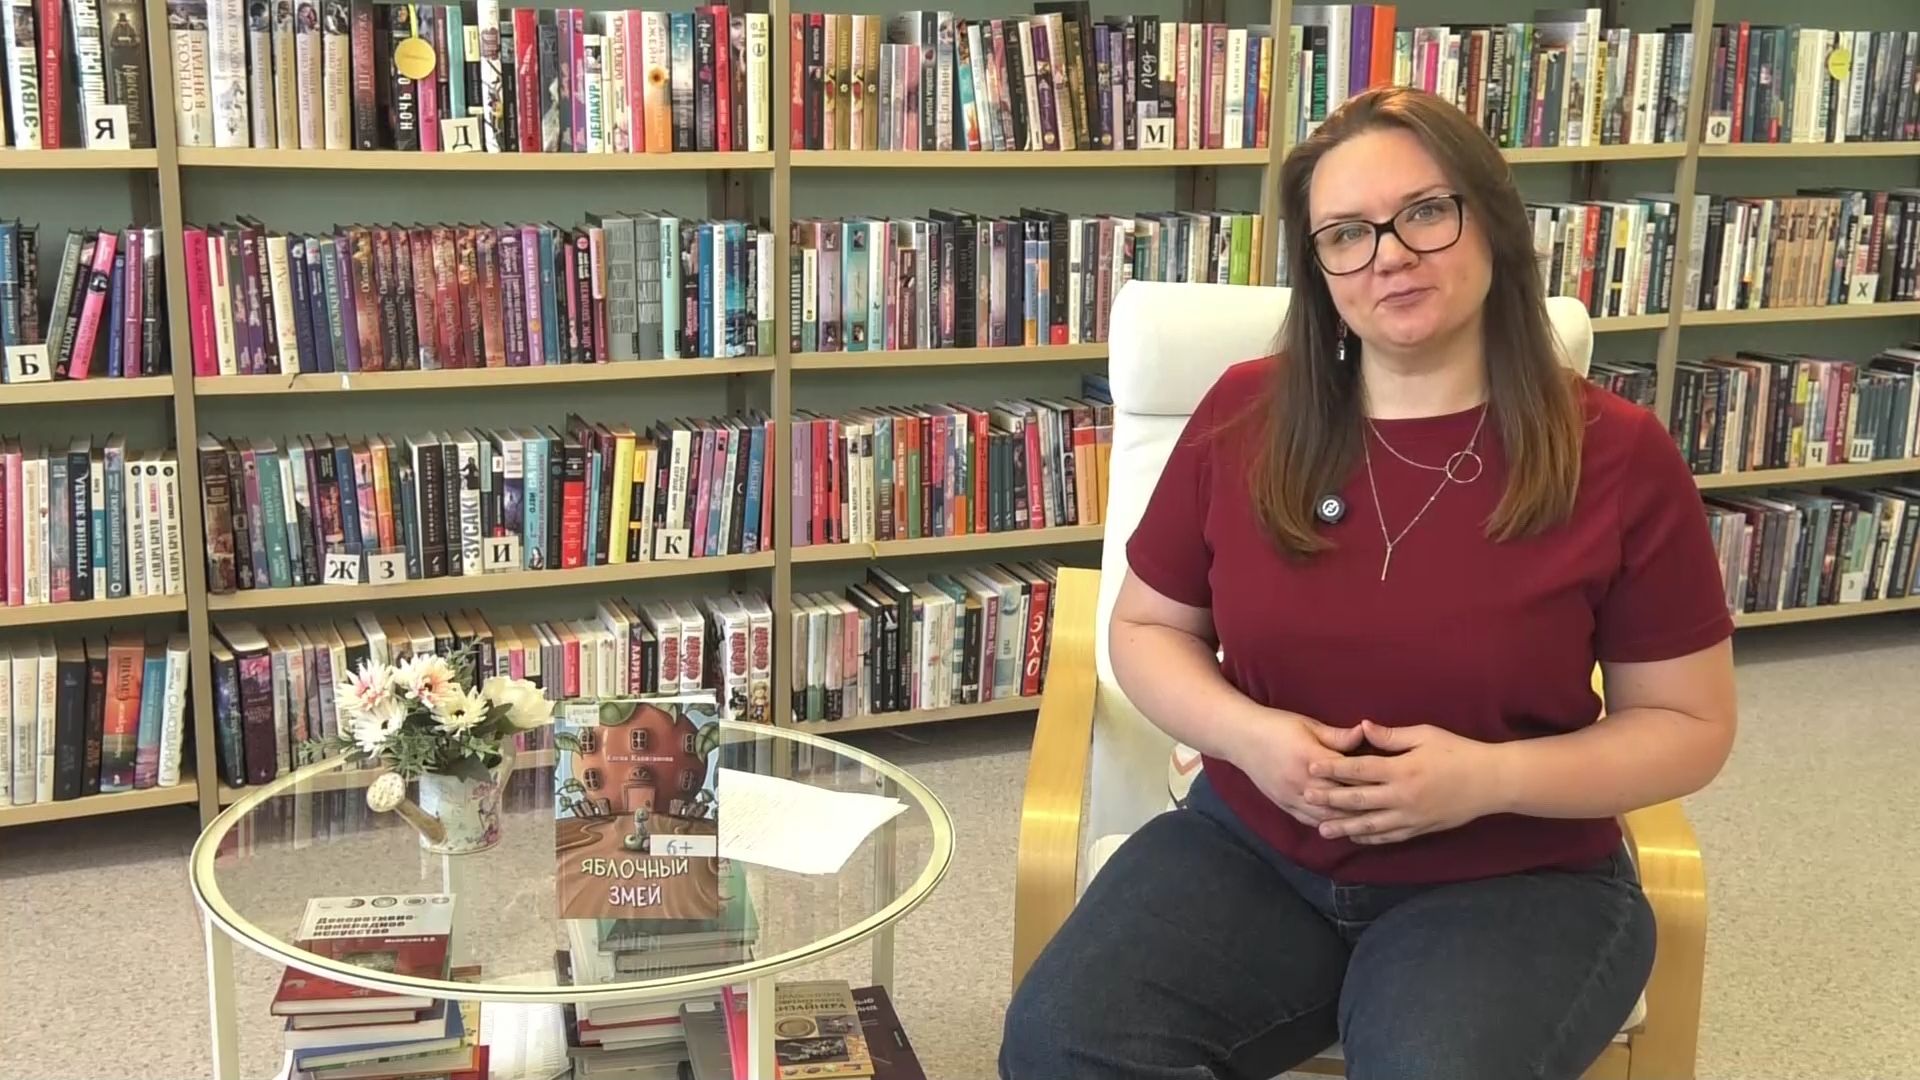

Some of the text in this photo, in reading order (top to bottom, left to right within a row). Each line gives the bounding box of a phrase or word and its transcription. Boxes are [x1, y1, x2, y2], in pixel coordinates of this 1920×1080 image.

[177, 33, 194, 112] СТРЕКОЗА
[192, 36, 206, 109] В ЯНТАРЕ
[19, 63, 39, 128] ЭТВУД
[1592, 69, 1604, 135] ЛЕТНИЙ БРАТ
[398, 92, 414, 130] НОЧЬ
[588, 84, 602, 140] ДЕЛАКУР
[95, 118, 115, 139] Я
[452, 125, 473, 150] Д
[1145, 125, 1165, 144] М
[1711, 121, 1726, 138] Ф
[325, 252, 336, 285] МАРТЕ
[1856, 282, 1869, 298] Х
[330, 294, 342, 337] ФИАЛКИ
[57, 316, 77, 363] ВЫСОТКА
[18, 353, 40, 376] Б
[1811, 447, 1822, 463] Ч
[1852, 443, 1870, 459] Ш
[74, 473, 89, 578] УТРЕННЯЯ ЗВЕЗДА
[110, 494, 121, 581] ТЮРЕМНЫЙ ДОКТОР
[463, 501, 480, 559] ЗУСАК
[133, 524, 144, 581] САНДРА БРАУН
[149, 519, 161, 578] САНДРА БРАУН
[167, 524, 180, 582] САНДРА БРАУН
[493, 543, 511, 563] И
[664, 536, 682, 555] К
[329, 560, 357, 579] Ж
[380, 560, 395, 579] З
[1026, 614, 1044, 677] ЭХО
[666, 839, 694, 855] 6+
[581, 856, 689, 880] ЯБЛОЧНЫЙ
[608, 883, 662, 907] ЗМЕЙ
[313, 928, 389, 937] искусство
